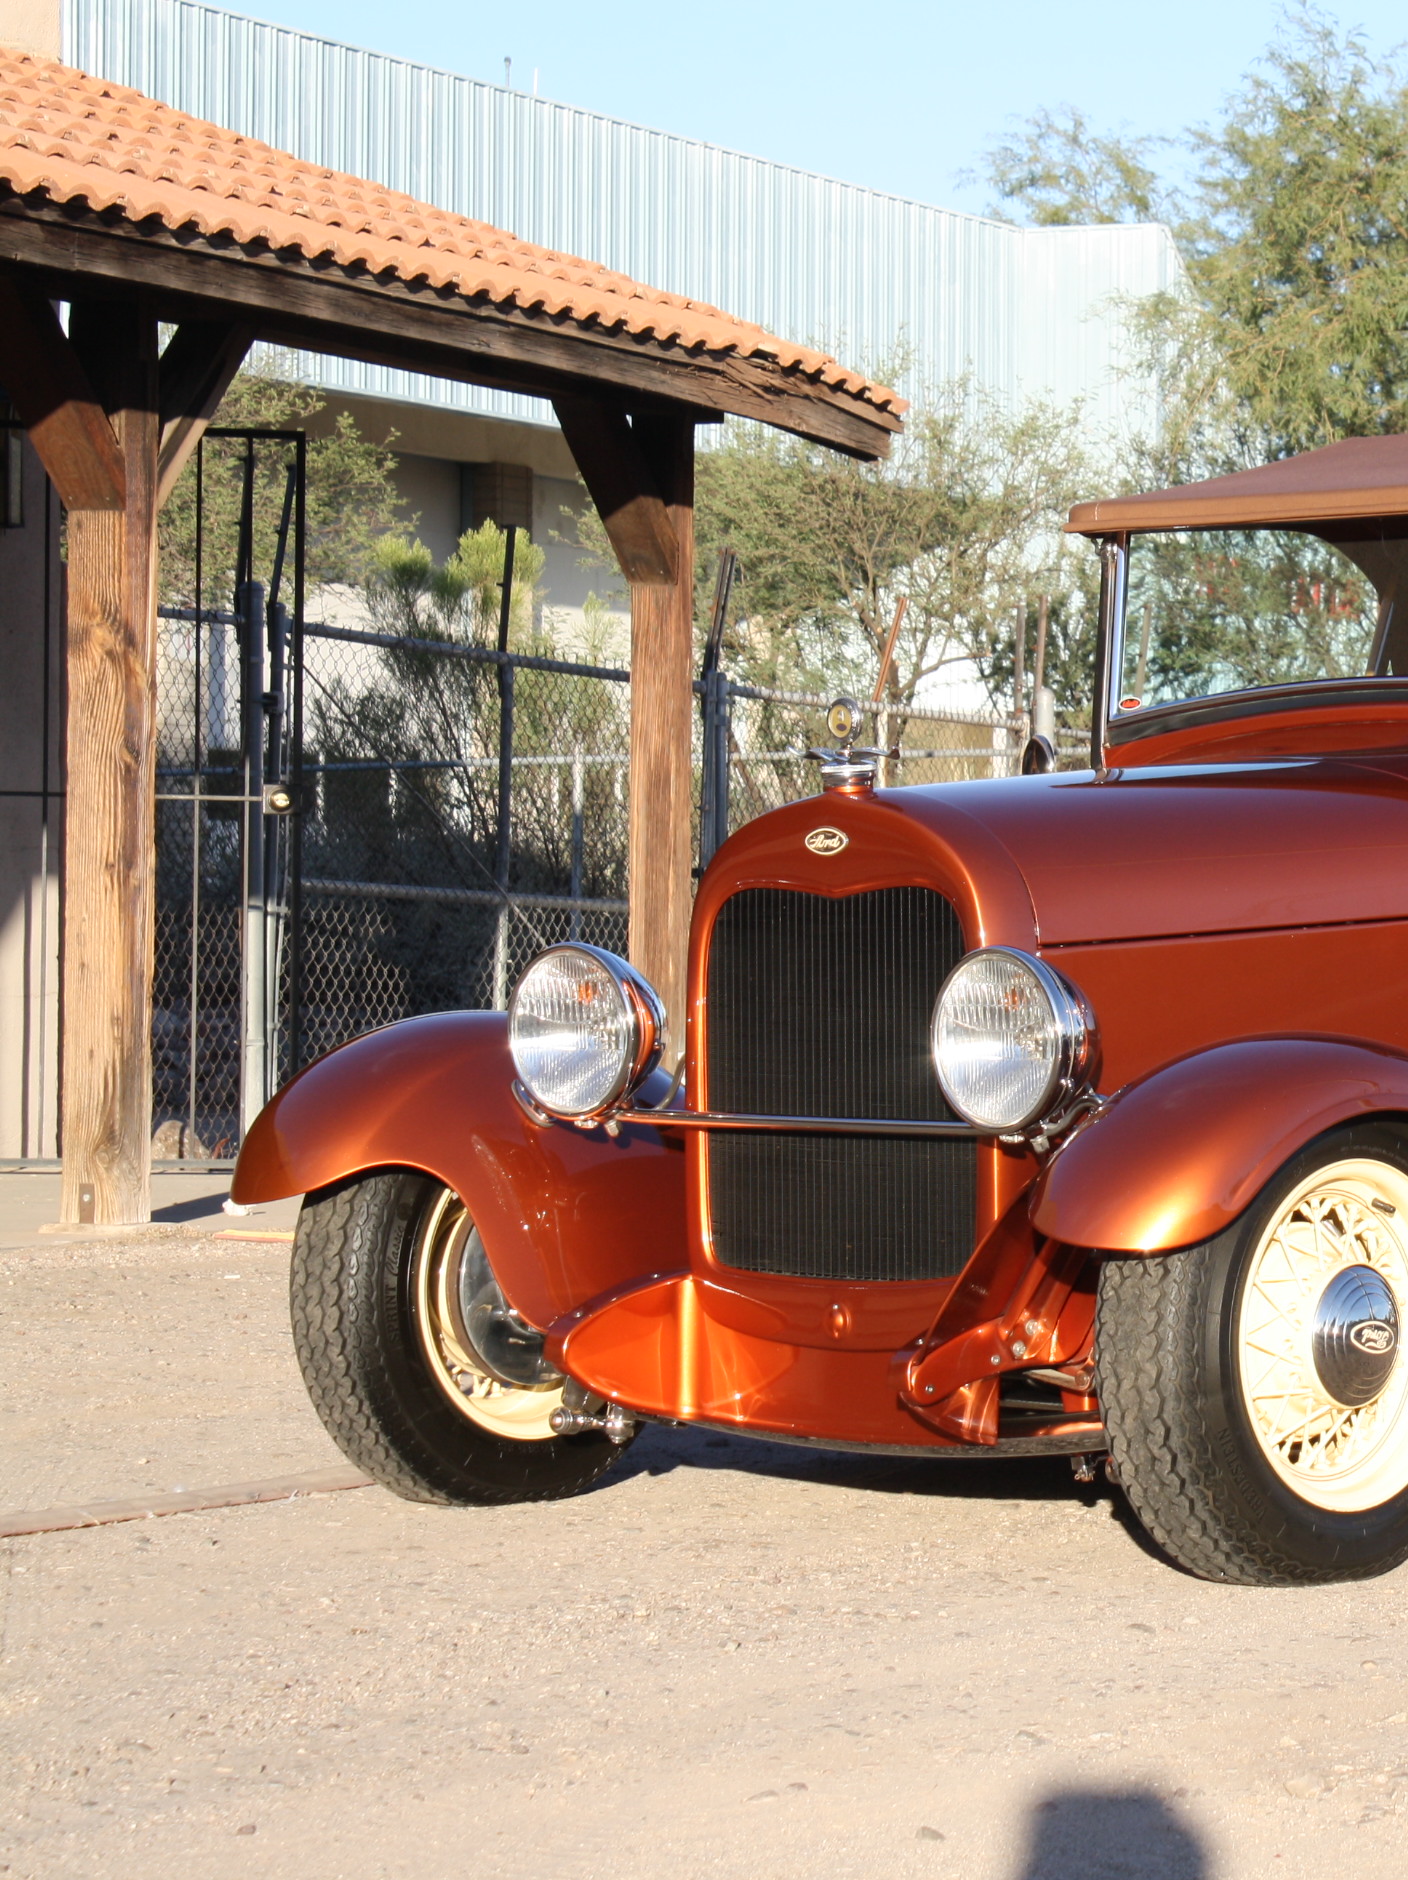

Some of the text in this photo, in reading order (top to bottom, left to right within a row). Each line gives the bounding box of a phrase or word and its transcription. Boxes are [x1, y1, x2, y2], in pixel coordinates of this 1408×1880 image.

[809, 833, 840, 848] Ford
[384, 1224, 404, 1343] SPRINT Classic
[1361, 1328, 1389, 1349] Ford
[1217, 1427, 1268, 1522] VREDESTEIN
